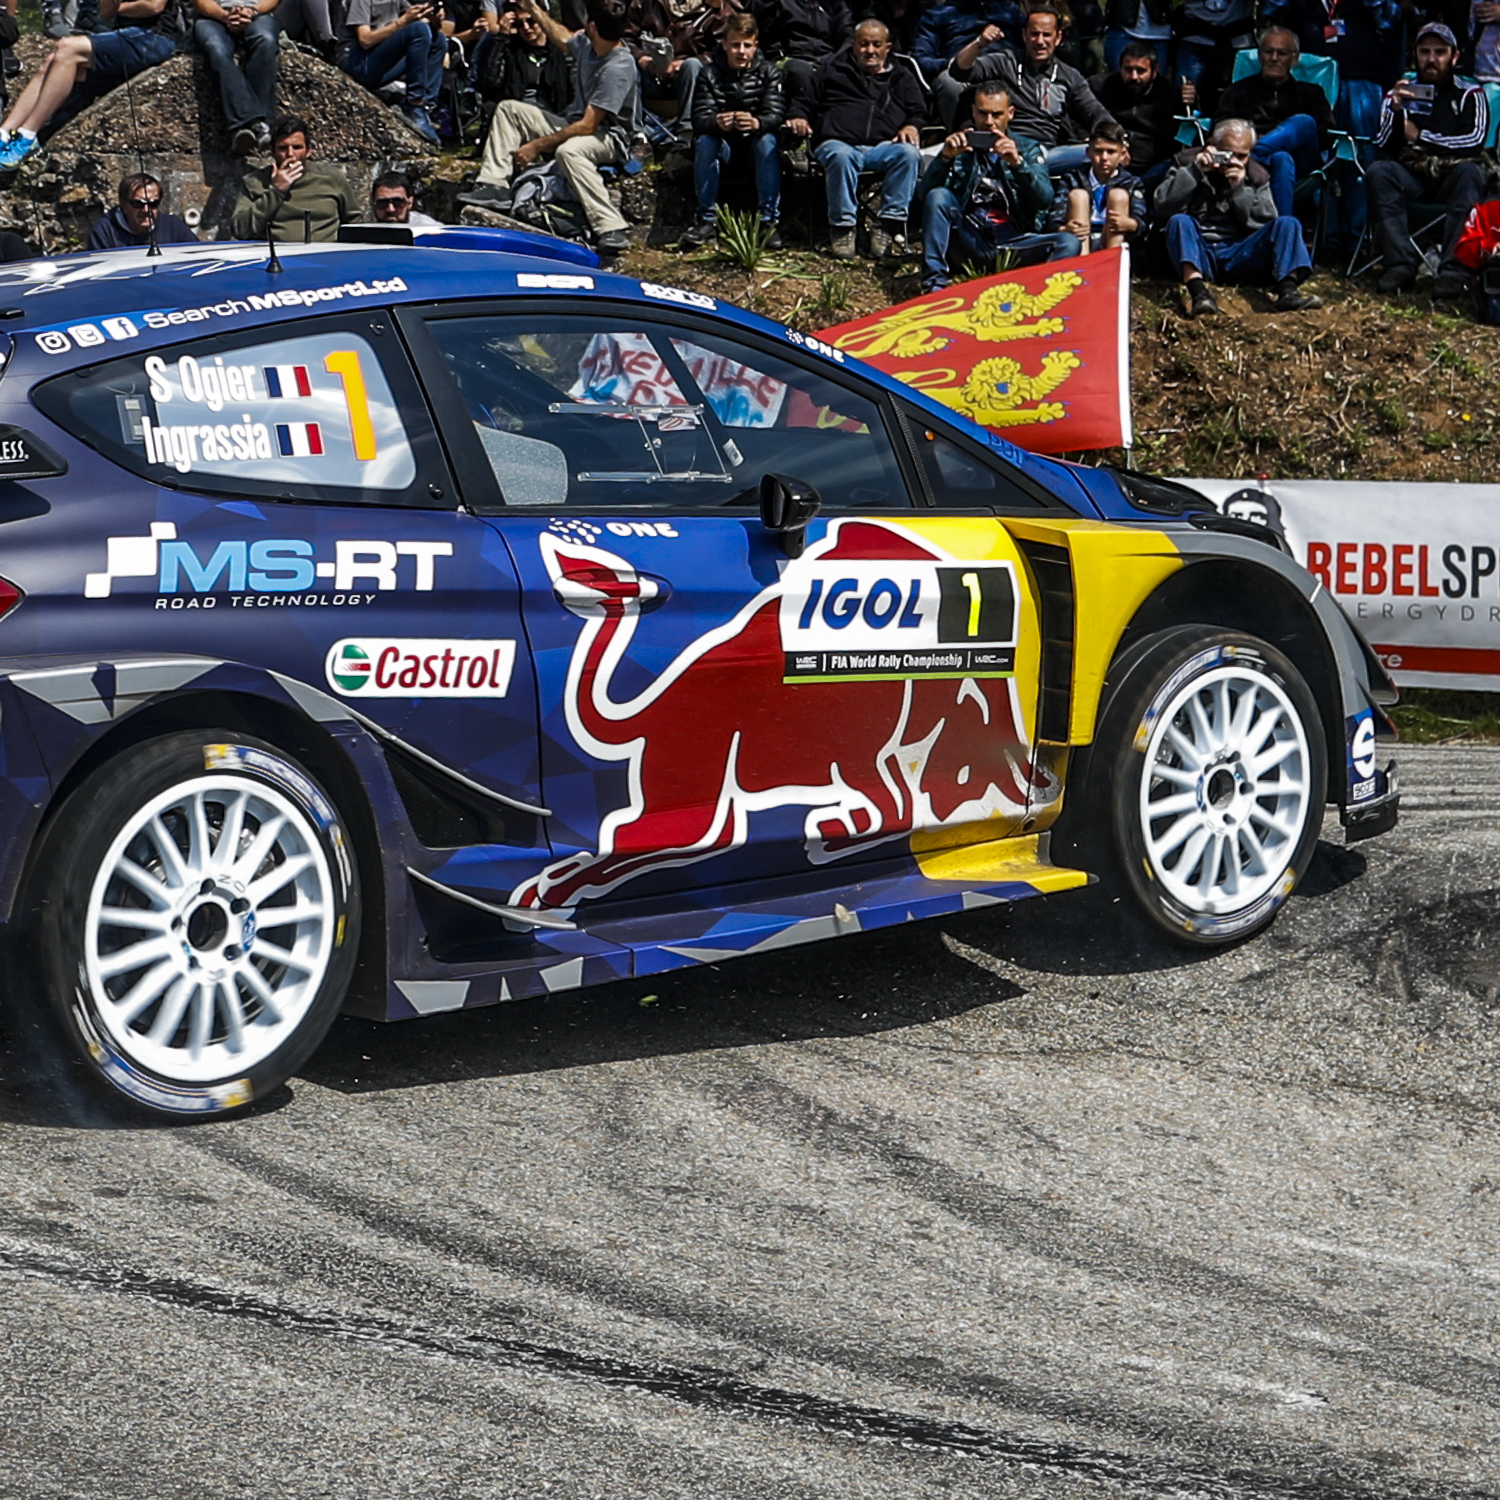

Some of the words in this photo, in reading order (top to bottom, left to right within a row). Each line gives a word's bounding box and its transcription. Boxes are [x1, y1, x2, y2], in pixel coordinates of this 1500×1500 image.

[640, 281, 718, 309] sparco
[803, 336, 845, 364] ONE
[143, 355, 173, 404] S
[177, 355, 257, 412] Ogier
[322, 350, 378, 462] 1
[141, 413, 273, 474] Ingrassia
[605, 522, 679, 538] ONE
[154, 595, 218, 610] ROAD
[230, 593, 378, 608] TECHNOLOGY
[797, 577, 925, 630] IGOL
[961, 572, 982, 637] 1
[375, 645, 502, 690] Castrol
[795, 655, 818, 666] WRC
[830, 655, 849, 669] FIA
[849, 654, 877, 669] World
[877, 653, 902, 670] Rally
[902, 652, 963, 670] Championship
